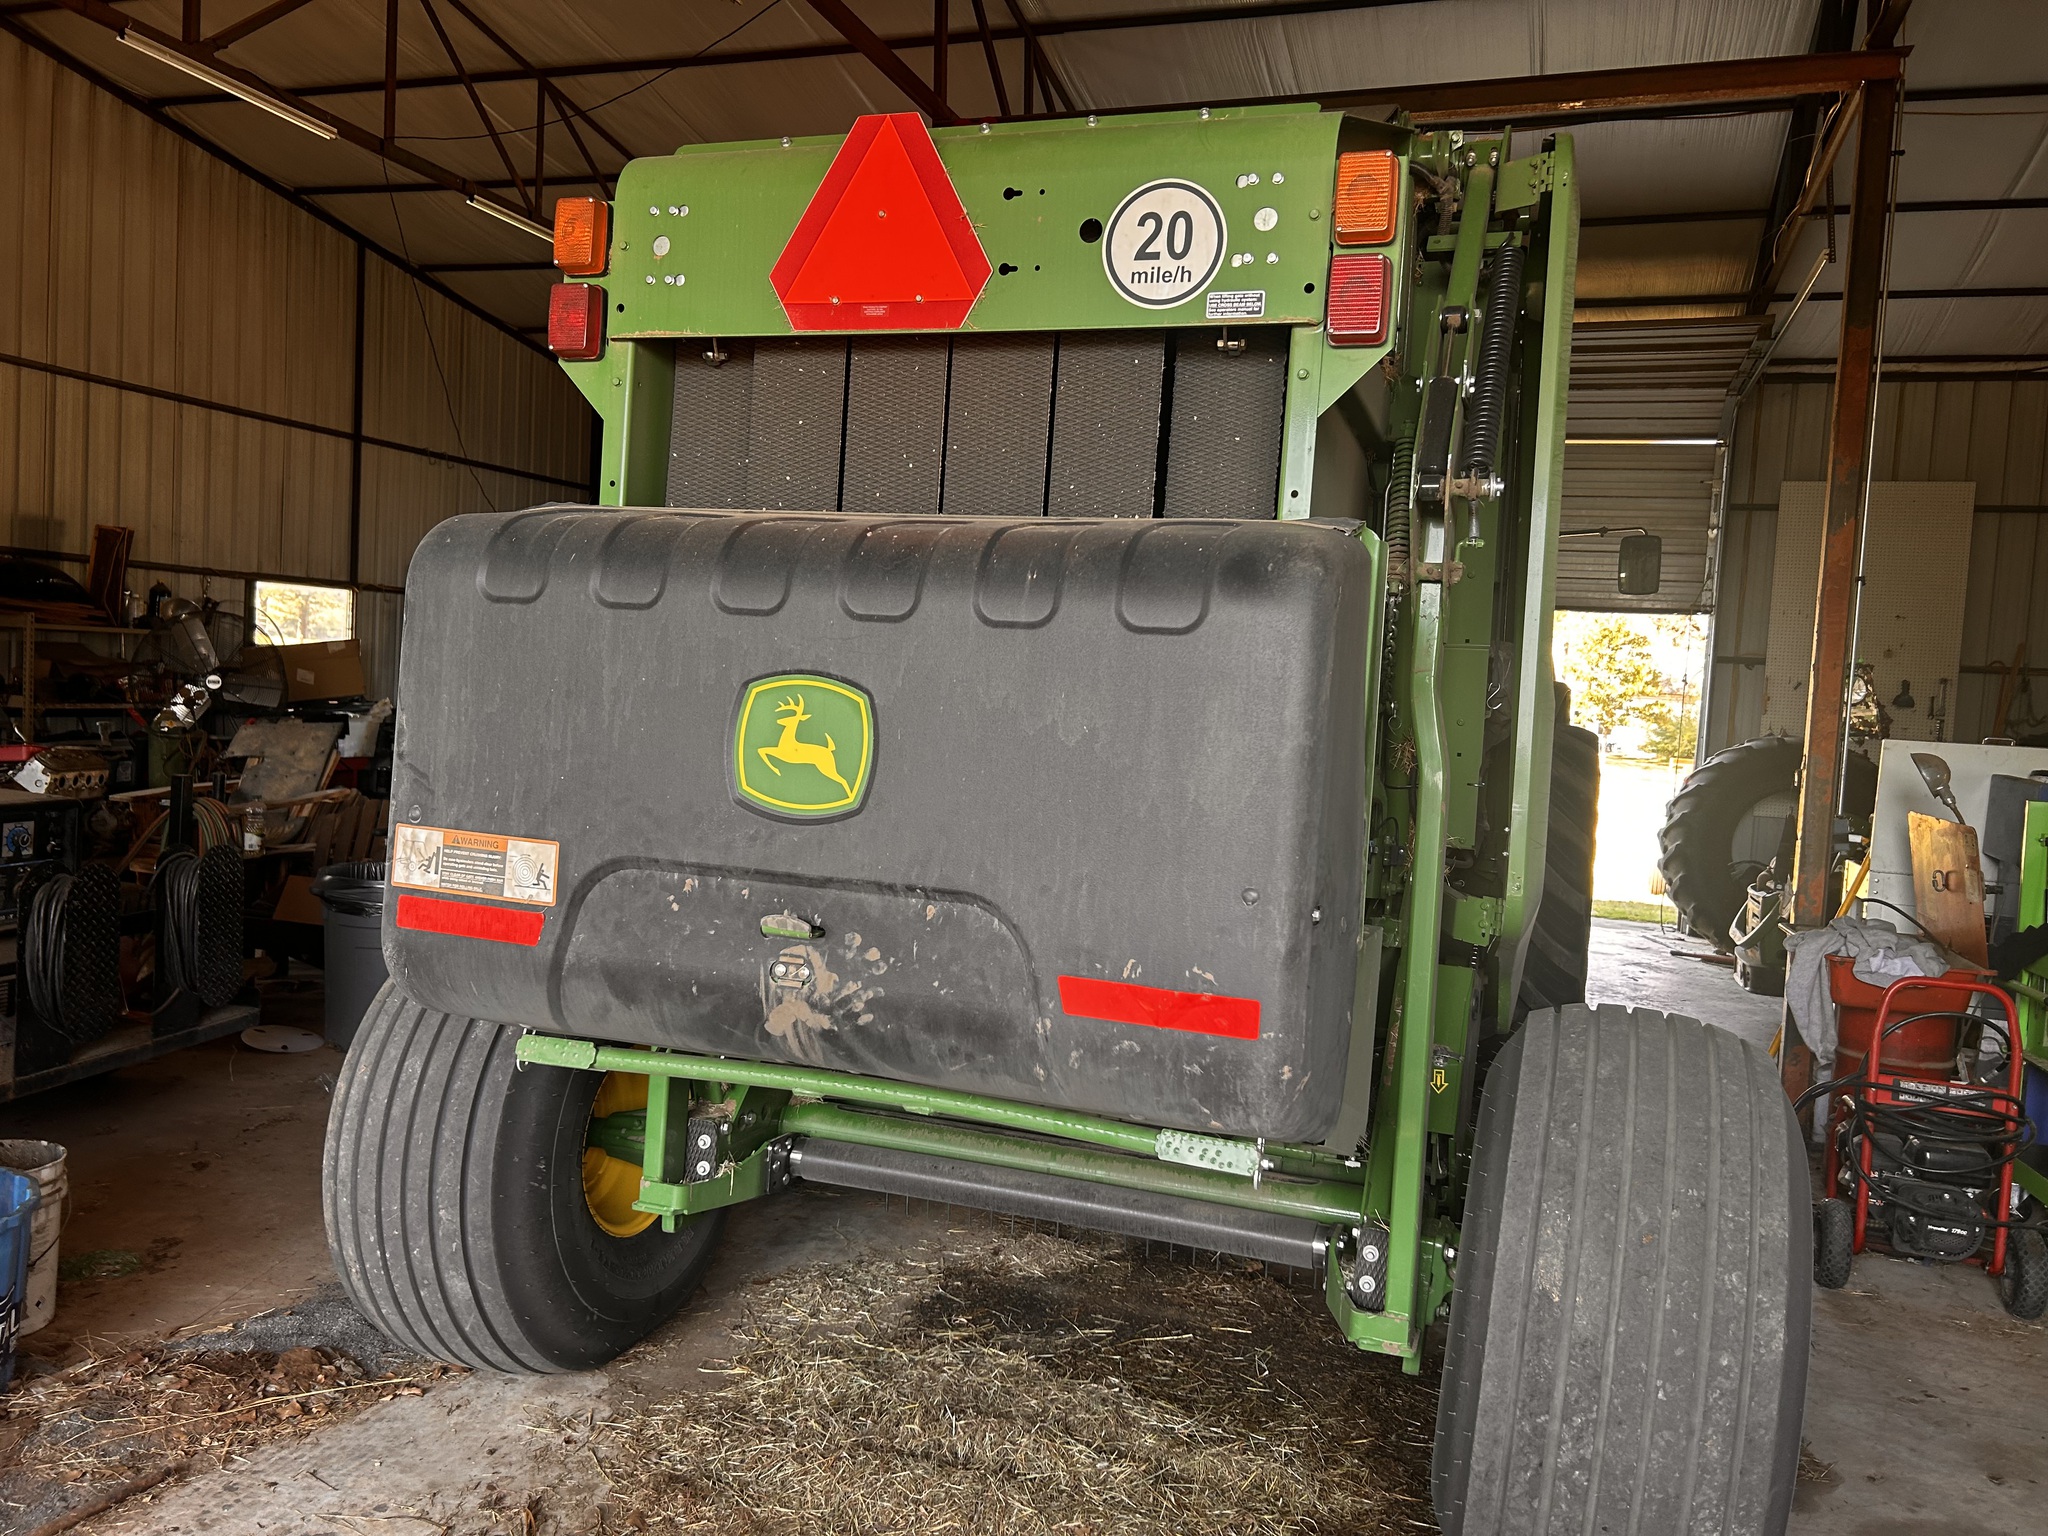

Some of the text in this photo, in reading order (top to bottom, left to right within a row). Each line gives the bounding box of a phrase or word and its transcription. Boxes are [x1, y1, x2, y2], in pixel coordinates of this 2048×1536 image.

[1133, 210, 1194, 262] 20
[1130, 266, 1192, 284] mile/h
[460, 836, 499, 849] WARNING
